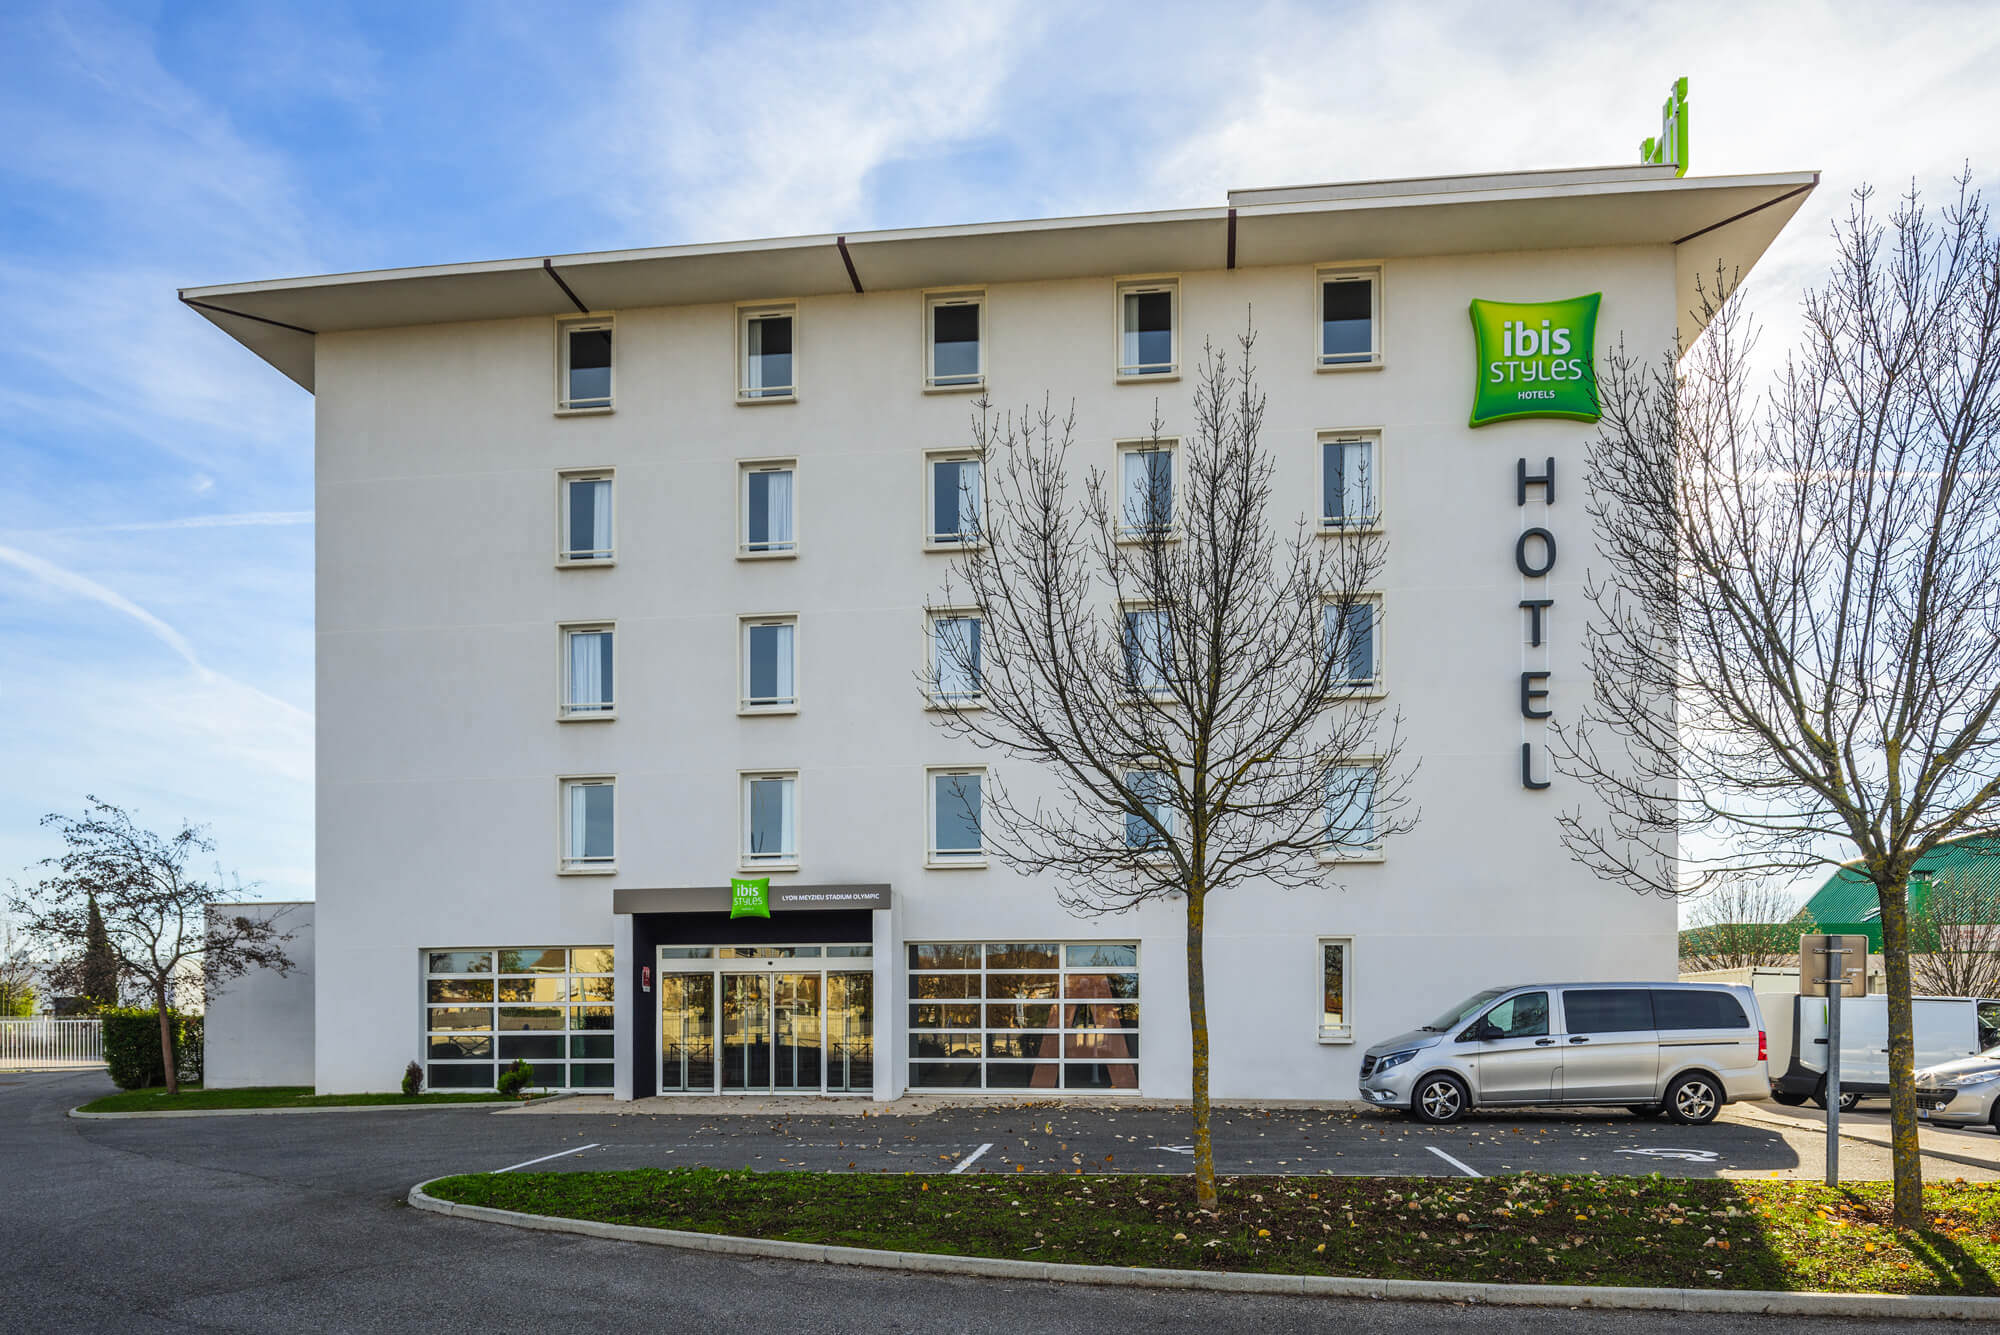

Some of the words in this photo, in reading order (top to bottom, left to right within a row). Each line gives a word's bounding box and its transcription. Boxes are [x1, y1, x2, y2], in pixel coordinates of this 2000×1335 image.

[1504, 320, 1571, 357] ibis
[1518, 390, 1556, 400] HOTELS
[1516, 457, 1557, 790] HOTEL
[736, 884, 760, 897] ibis
[825, 893, 852, 901] STADIUM
